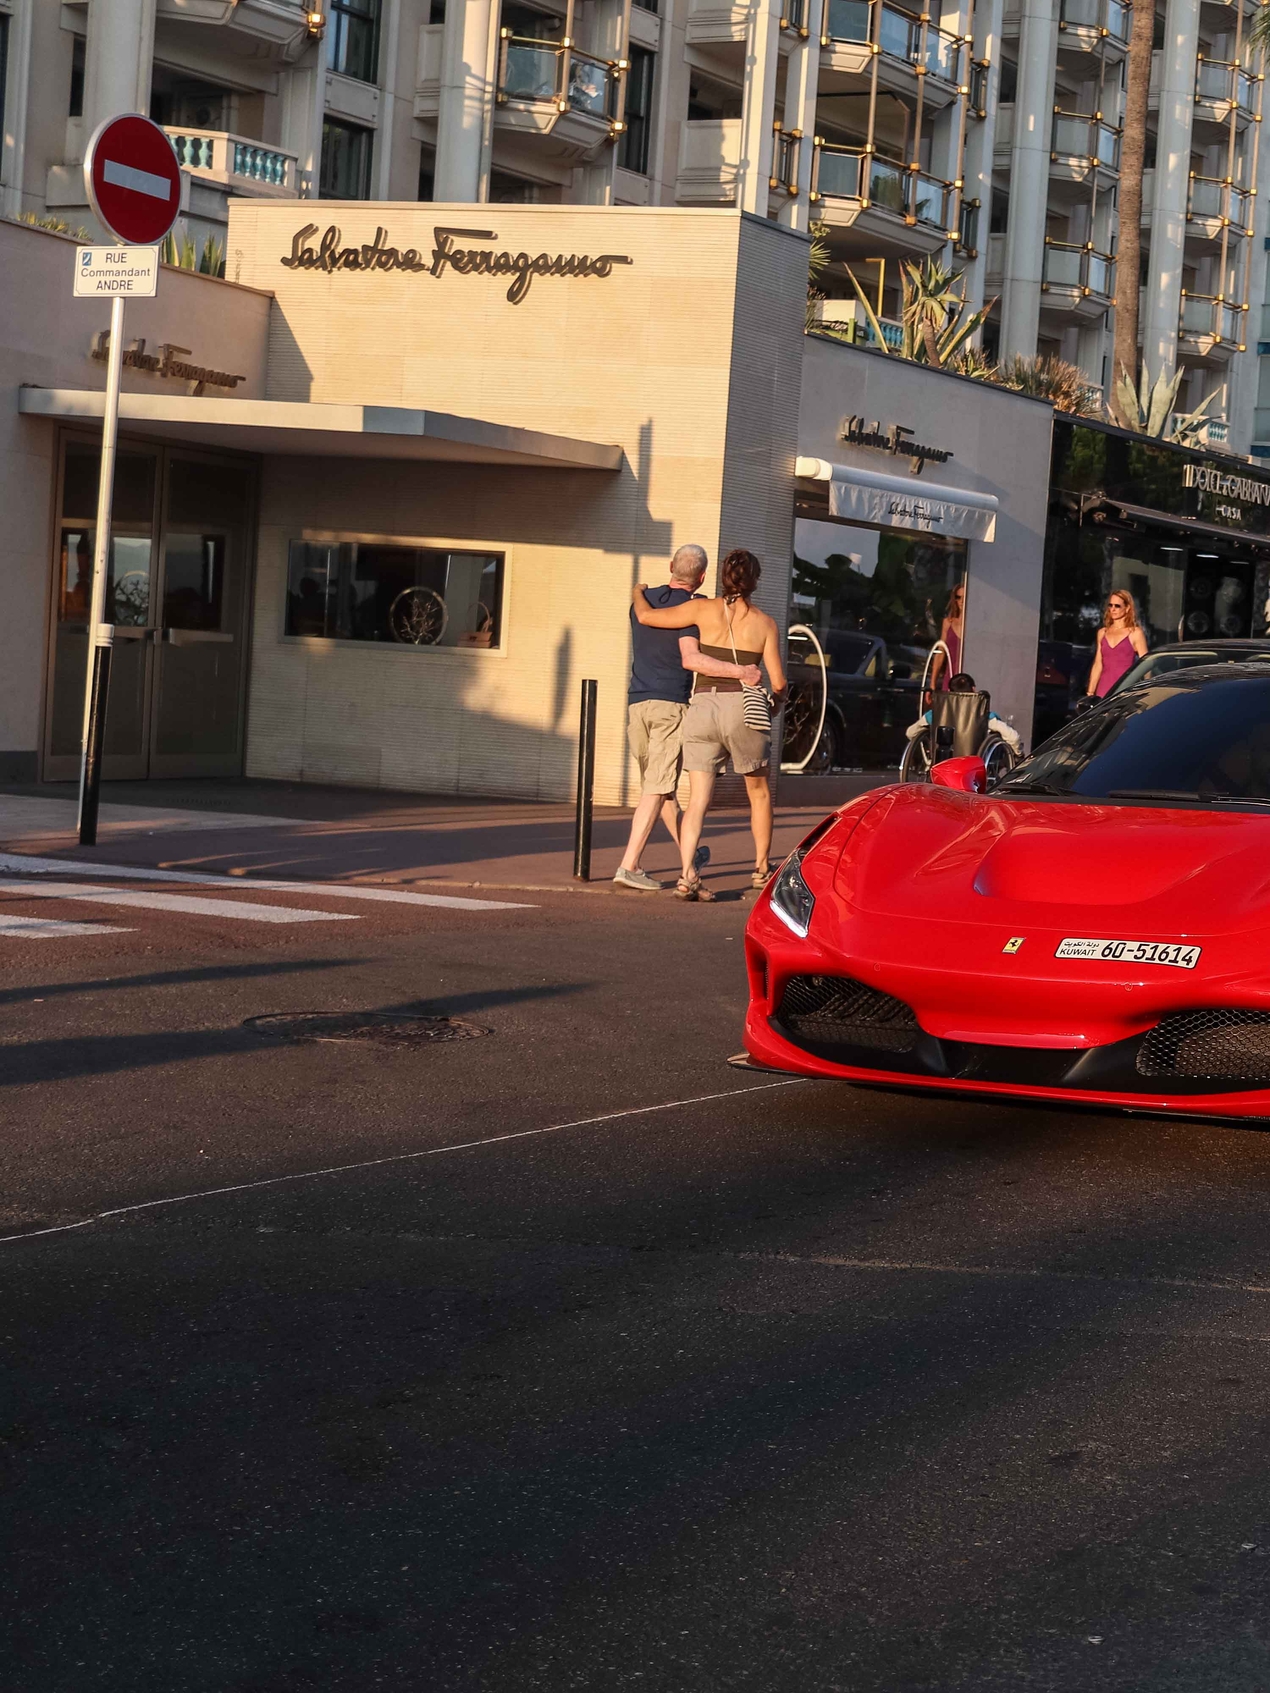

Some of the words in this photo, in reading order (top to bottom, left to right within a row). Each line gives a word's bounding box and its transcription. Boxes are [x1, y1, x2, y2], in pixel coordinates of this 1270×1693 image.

[105, 252, 127, 264] RUE
[281, 223, 427, 274] Salvatore
[429, 226, 633, 305] Ferragamo
[81, 267, 151, 278] Commandant
[96, 279, 133, 291] ANDRE
[1221, 504, 1242, 521] CASA
[1086, 941, 1100, 949] دولة
[1059, 948, 1097, 956] KUWAIT
[1101, 941, 1196, 966] 60-51614
